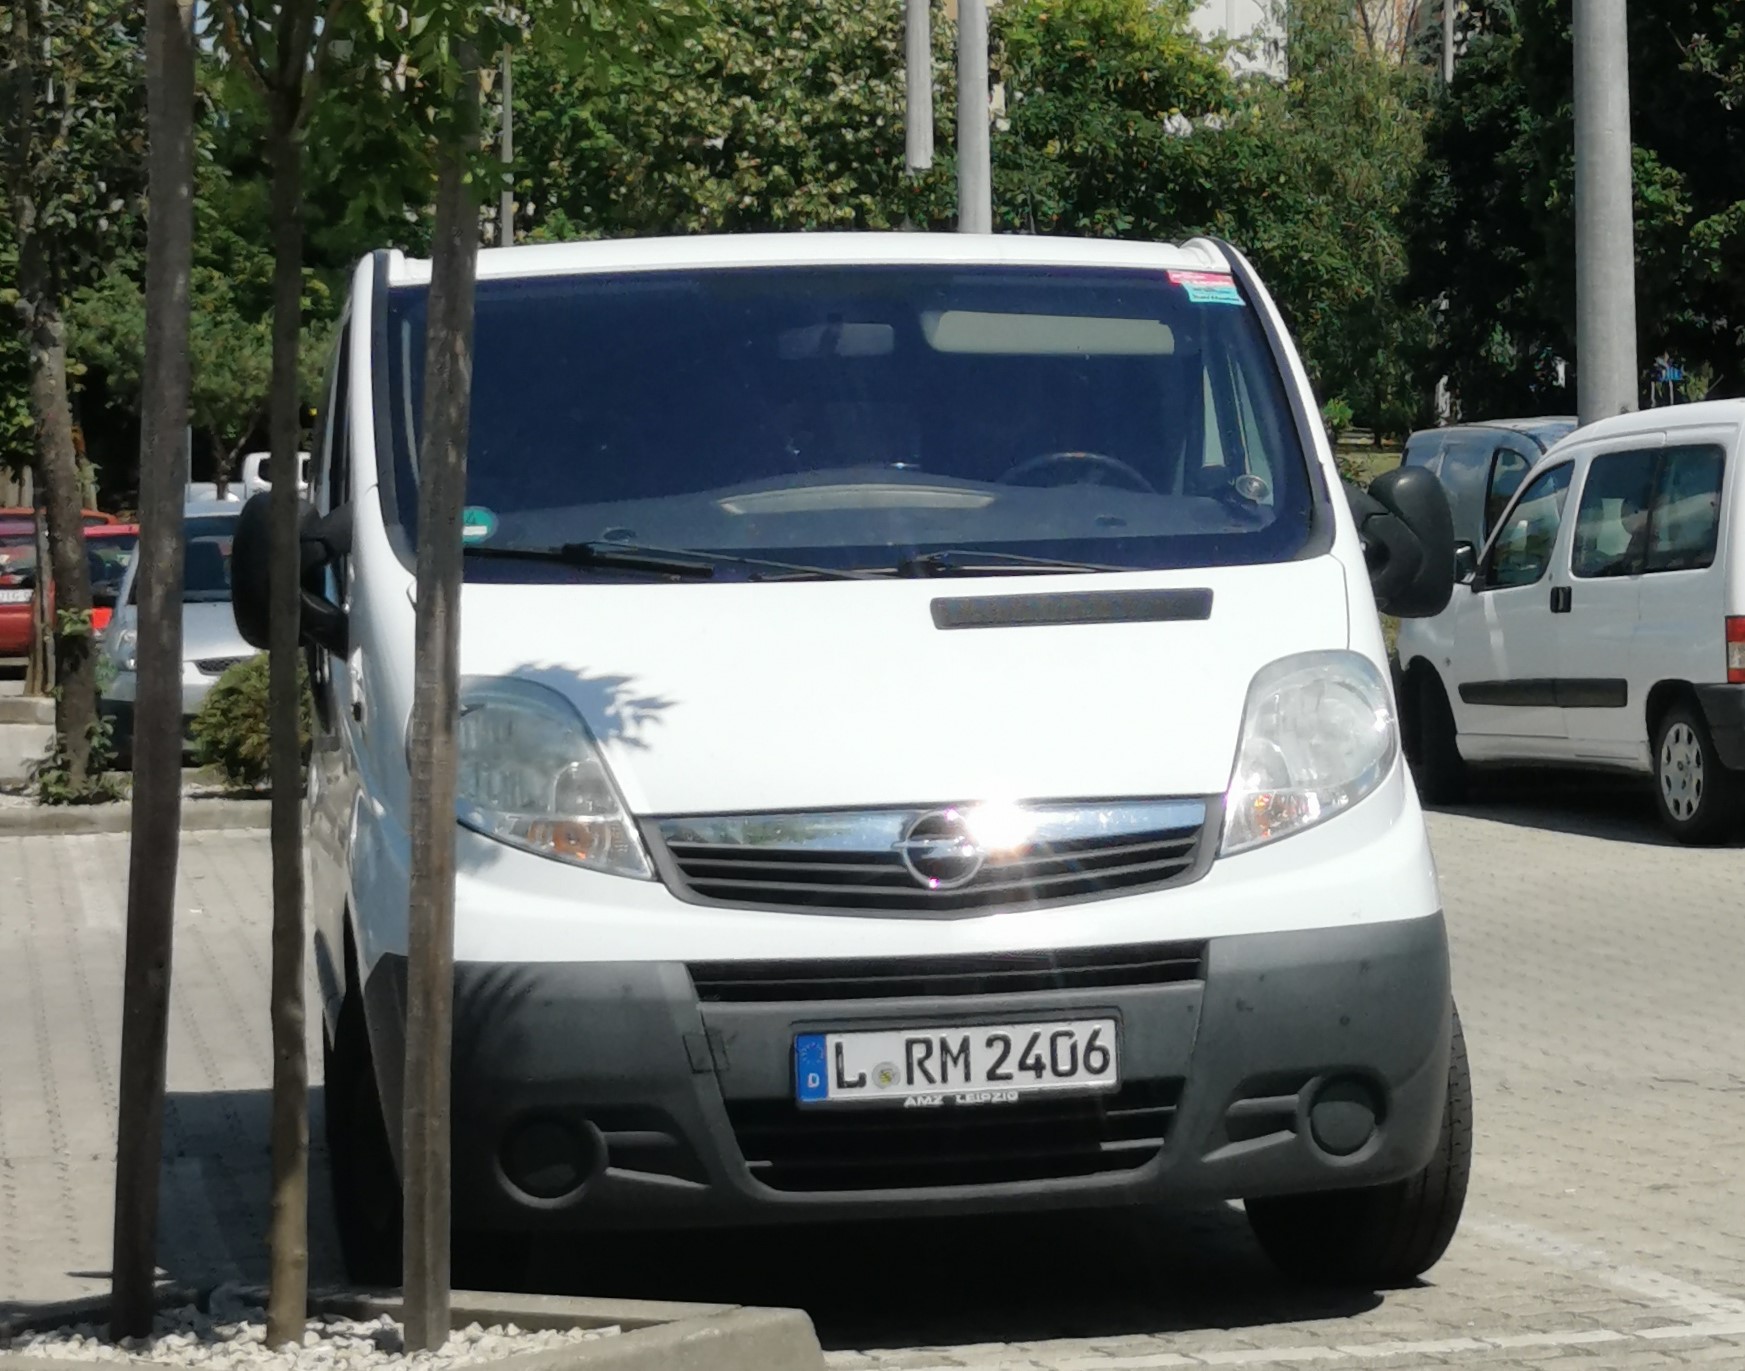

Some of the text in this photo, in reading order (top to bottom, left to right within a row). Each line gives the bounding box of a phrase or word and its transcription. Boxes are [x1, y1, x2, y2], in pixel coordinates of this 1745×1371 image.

[808, 1028, 1111, 1089] D L RM 2406
